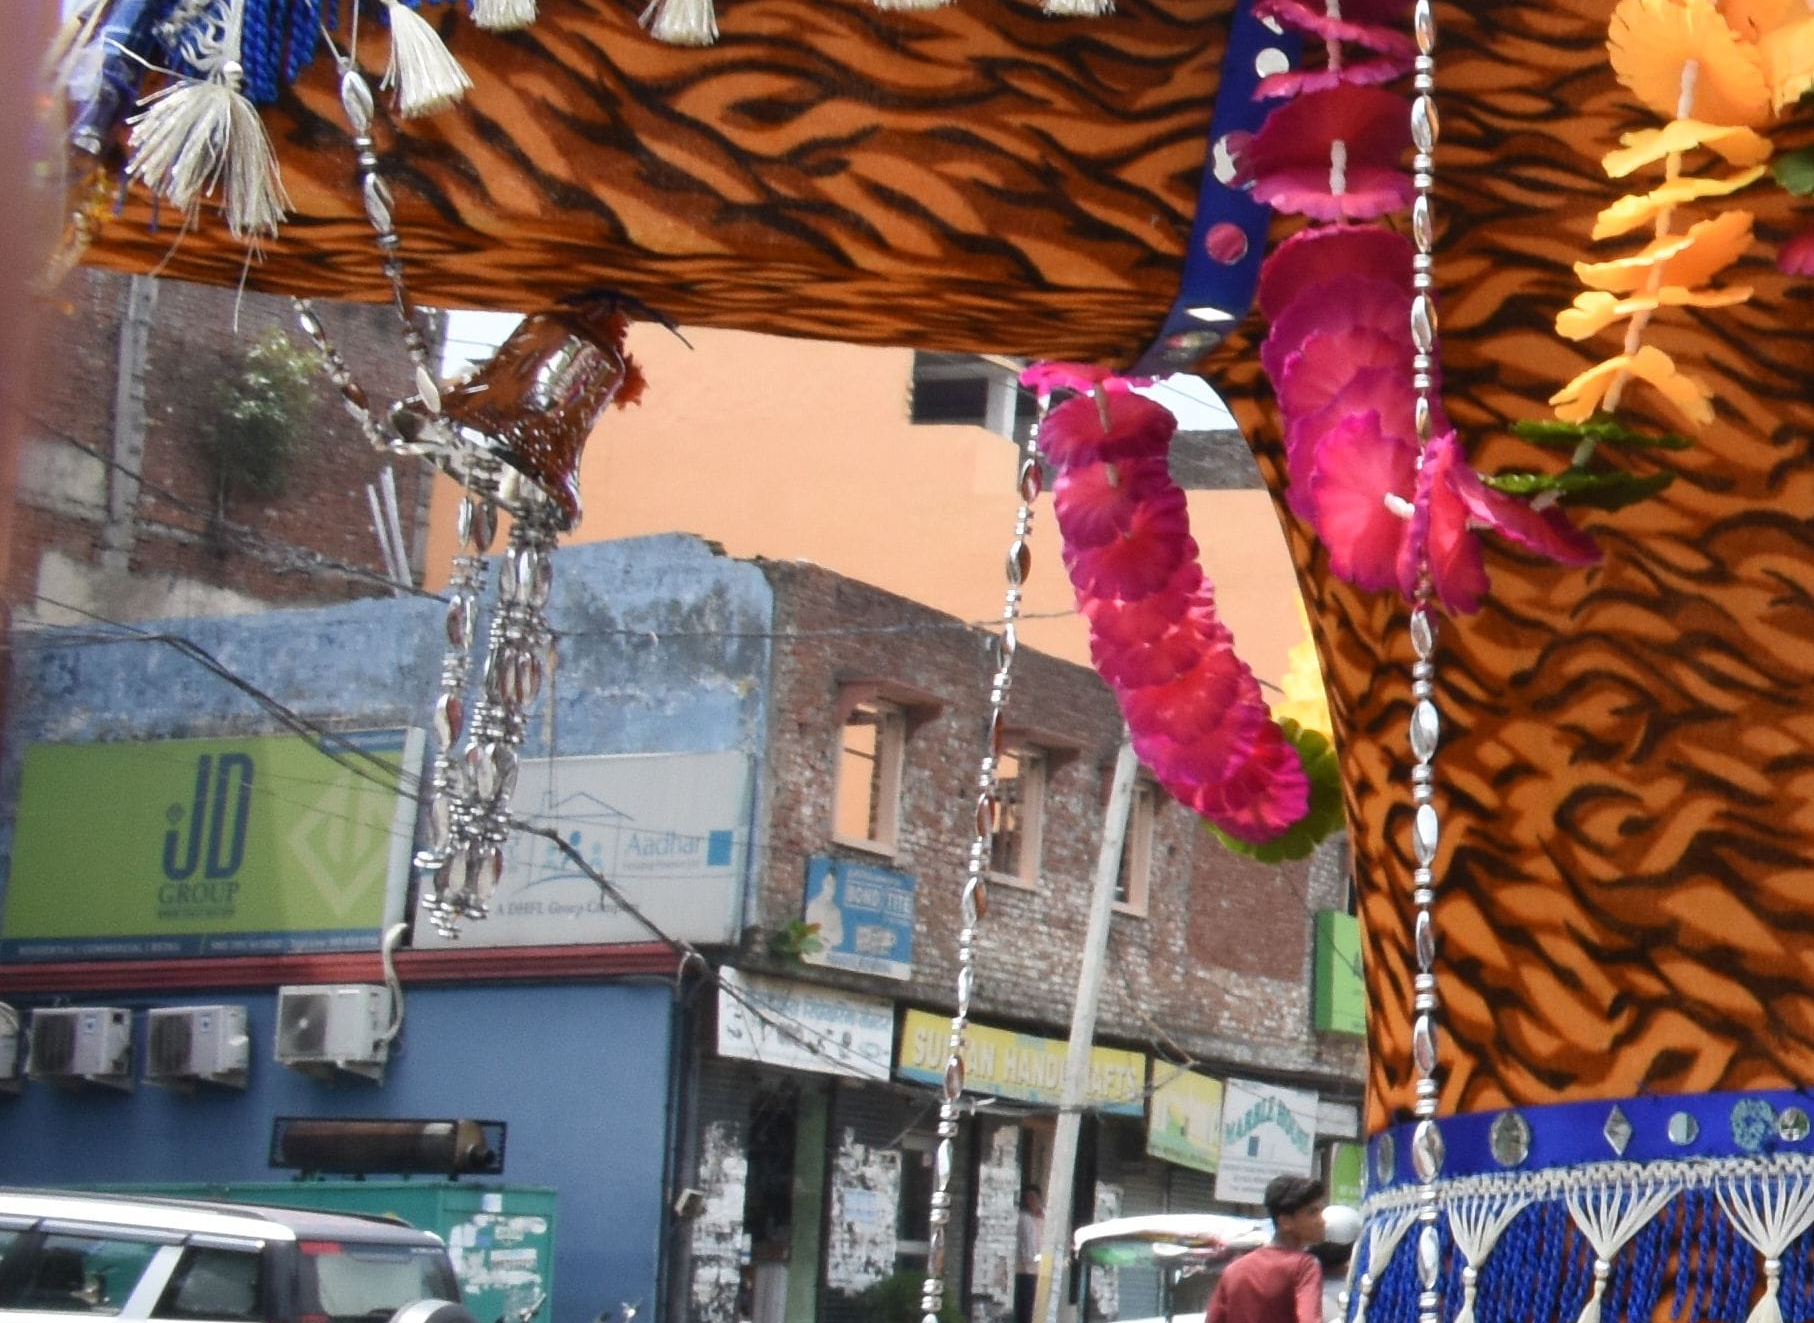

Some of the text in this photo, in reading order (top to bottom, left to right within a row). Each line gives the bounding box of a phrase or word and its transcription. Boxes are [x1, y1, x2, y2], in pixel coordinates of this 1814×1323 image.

[162, 753, 254, 880] JD
[158, 882, 240, 906] GROUP
[915, 1027, 1138, 1101] SUTAN HANDIAFTS
